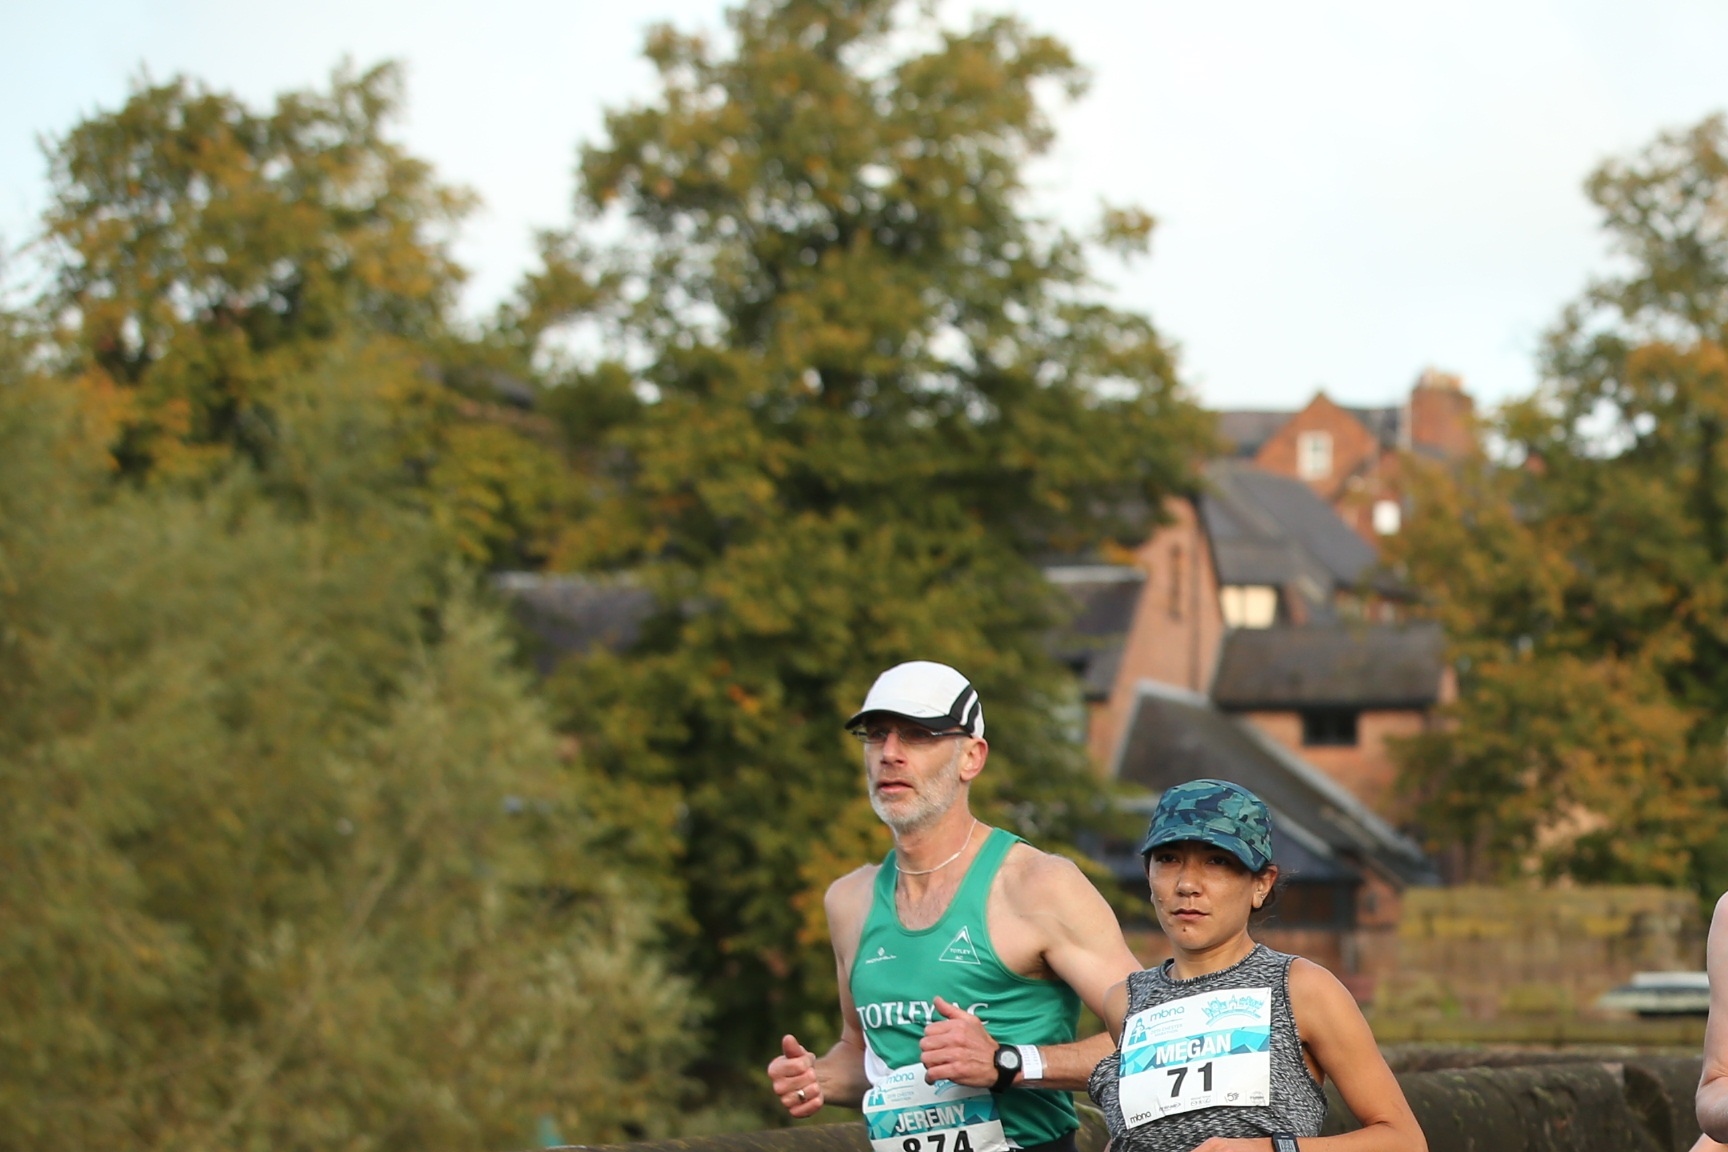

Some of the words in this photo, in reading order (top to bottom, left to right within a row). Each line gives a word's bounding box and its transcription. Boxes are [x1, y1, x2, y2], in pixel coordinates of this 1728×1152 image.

[856, 1001, 936, 1031] TOTLEY
[1150, 1006, 1185, 1022] mbna
[1156, 1033, 1232, 1065] MEGAN
[1167, 1062, 1213, 1098] 71
[895, 1103, 966, 1133] JEREMY
[1130, 1111, 1152, 1124] mbna
